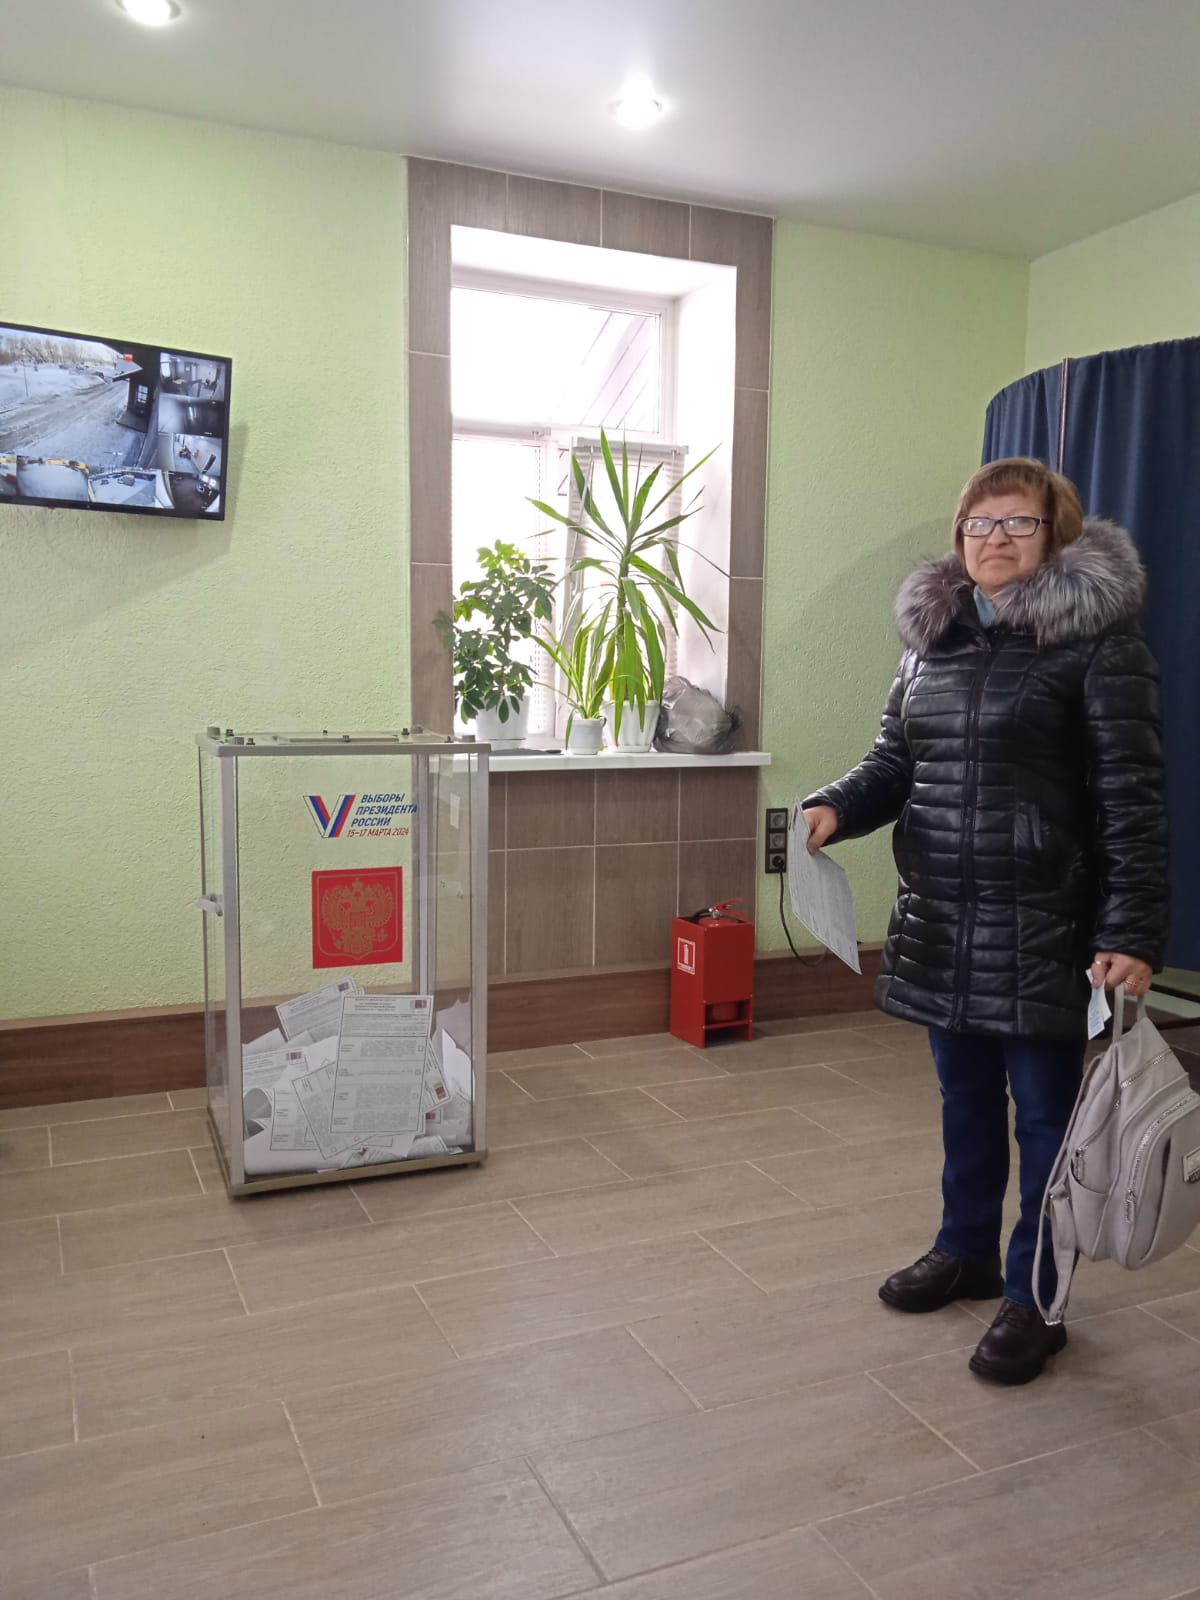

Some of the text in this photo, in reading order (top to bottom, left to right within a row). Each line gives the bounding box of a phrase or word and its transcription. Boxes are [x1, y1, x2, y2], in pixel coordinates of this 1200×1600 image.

[361, 793, 405, 803] ВЫБОРЫ
[356, 804, 418, 815] ПРЕЗИДЕНТА
[351, 817, 391, 827] РОССИИ
[368, 828, 391, 837] МАРТА
[392, 828, 409, 836] 2024
